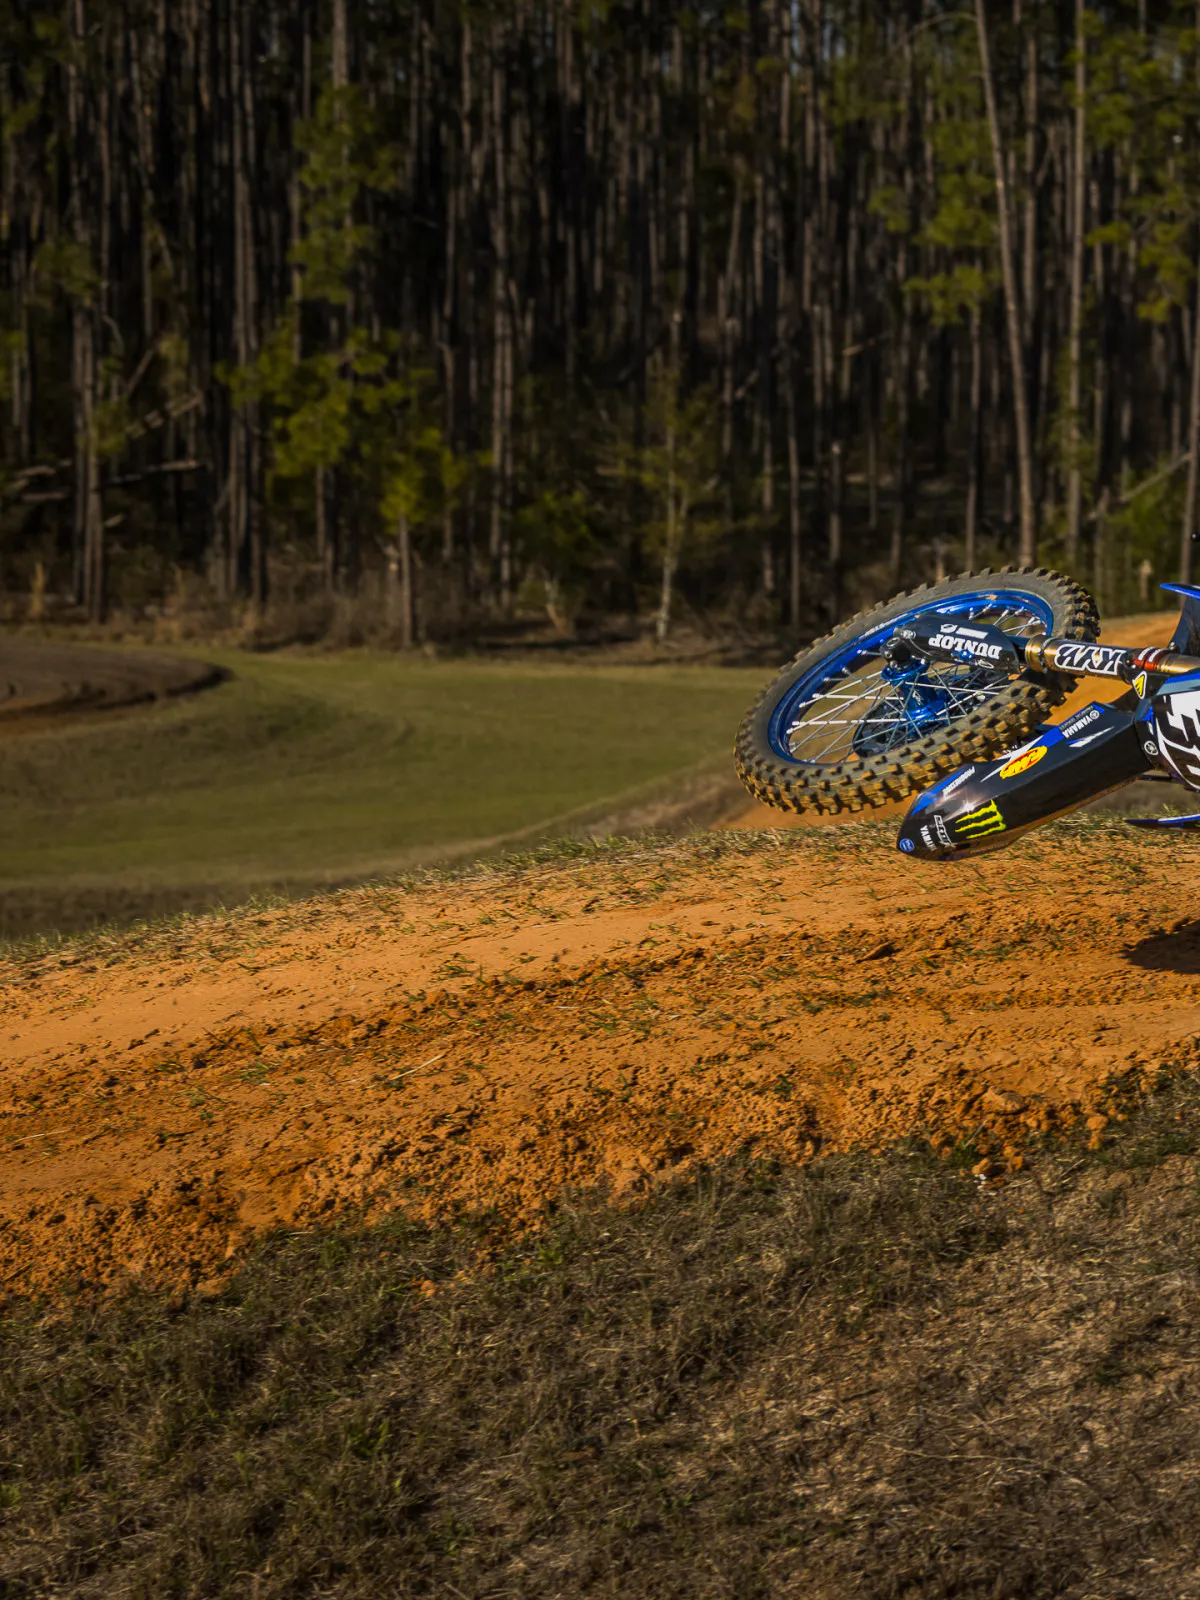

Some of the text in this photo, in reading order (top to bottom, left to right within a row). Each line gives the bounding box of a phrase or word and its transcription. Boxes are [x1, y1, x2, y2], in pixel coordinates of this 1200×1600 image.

[928, 632, 1003, 660] DUNLOP
[1054, 643, 1126, 676] KYB
[1061, 713, 1093, 739] YAMAHA
